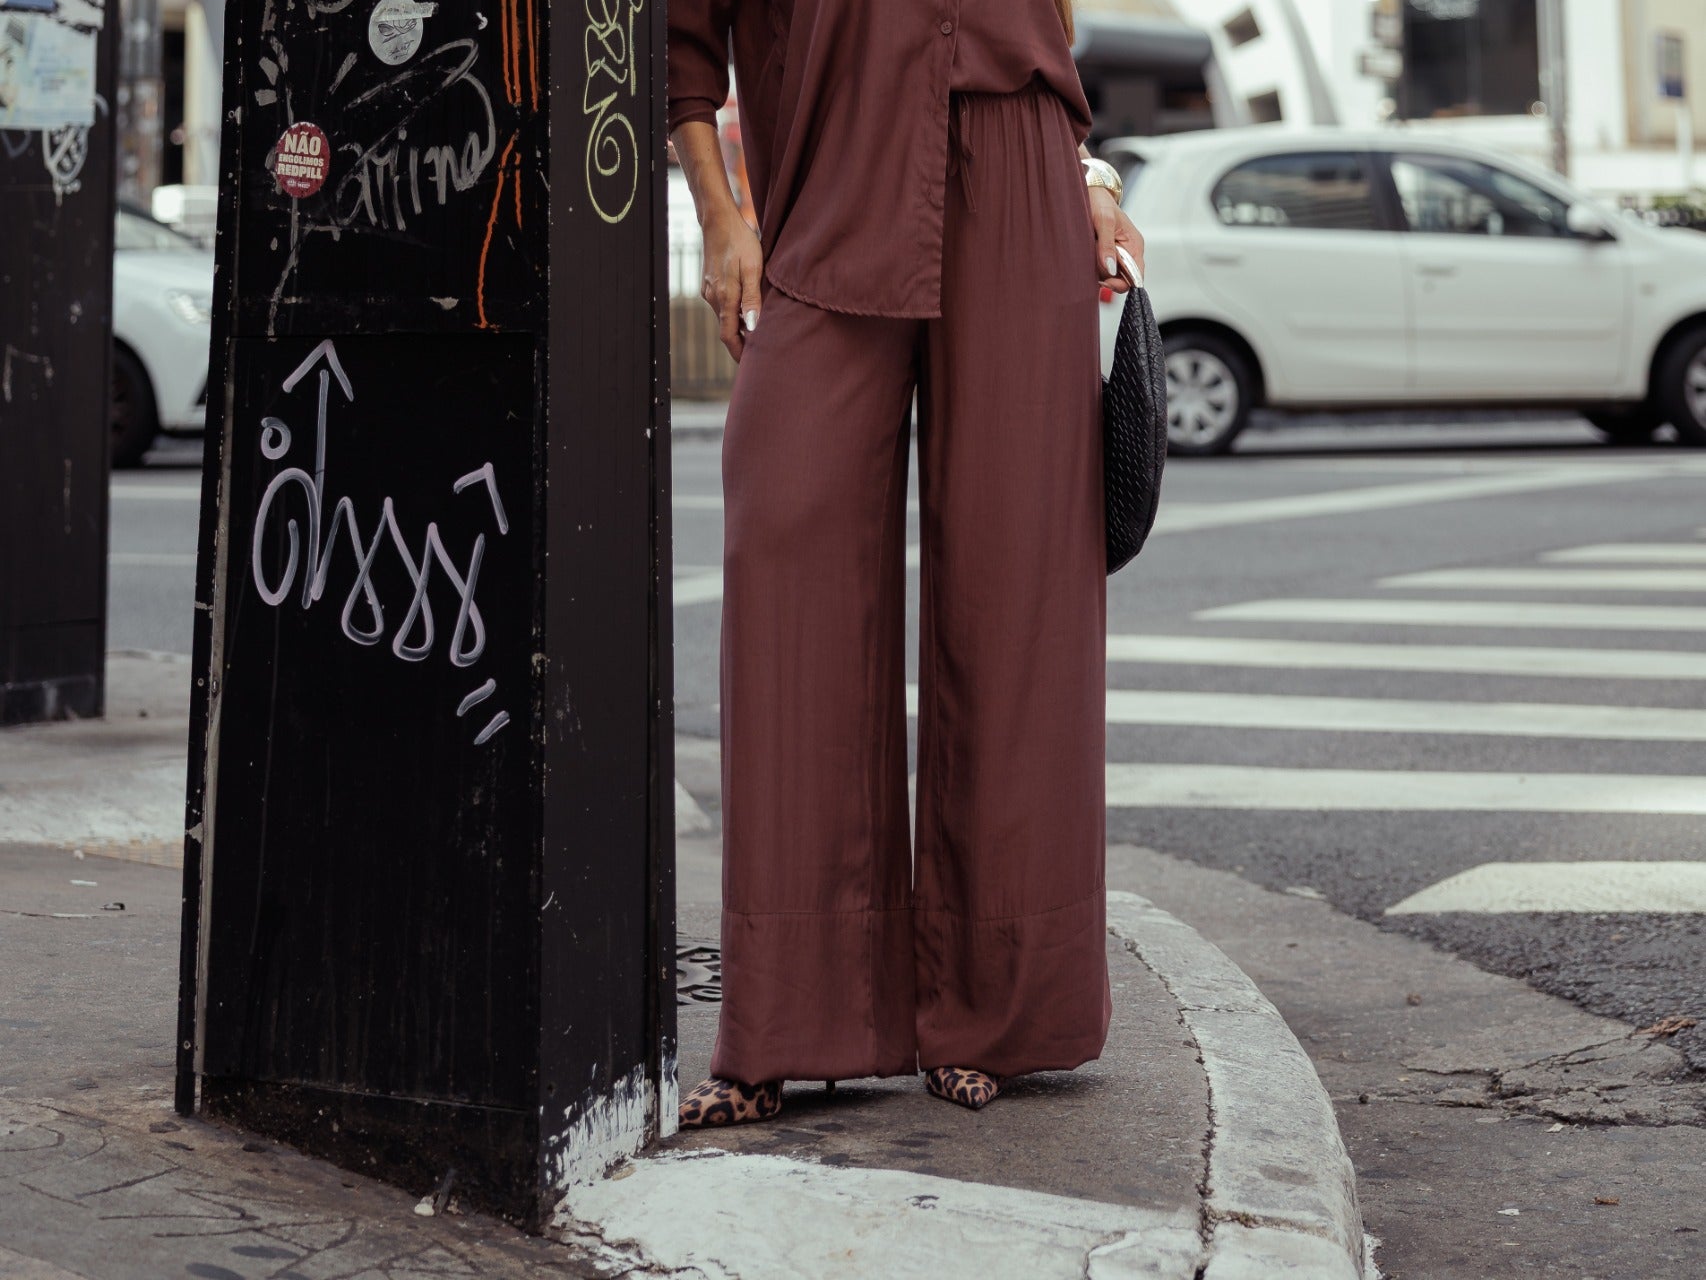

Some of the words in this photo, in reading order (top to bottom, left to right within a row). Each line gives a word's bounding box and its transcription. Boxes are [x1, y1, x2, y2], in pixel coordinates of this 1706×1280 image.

[284, 130, 321, 156] NÃO
[278, 153, 324, 167] ENGOLIMOS
[277, 163, 323, 180] REDPILL
